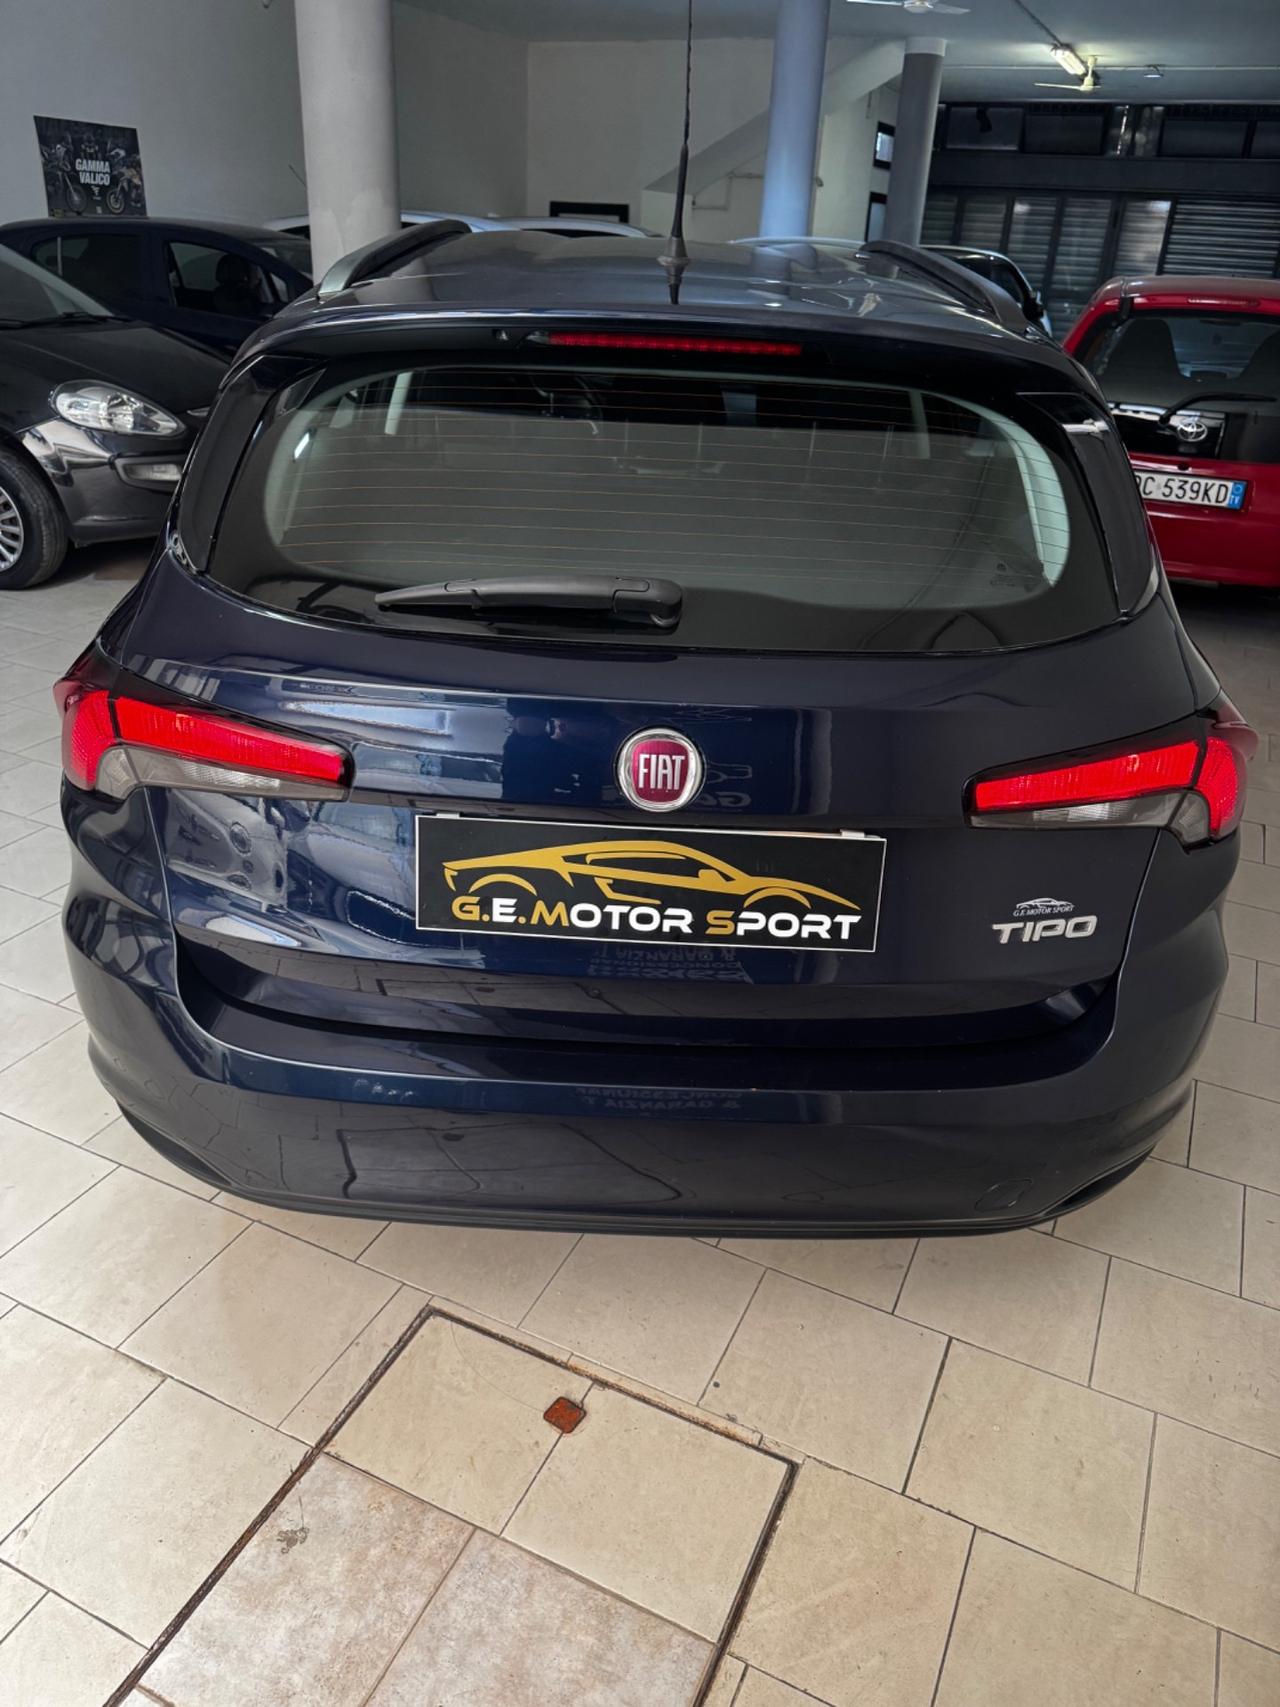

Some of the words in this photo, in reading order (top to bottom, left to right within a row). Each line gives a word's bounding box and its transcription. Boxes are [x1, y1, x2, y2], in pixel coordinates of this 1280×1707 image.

[75, 158, 111, 174] GAMMA
[79, 171, 111, 186] VALICO
[1161, 478, 1229, 504] 539KD
[638, 753, 686, 790] FIAT
[705, 910, 863, 940] SPORT
[992, 915, 1098, 944] TIPO
